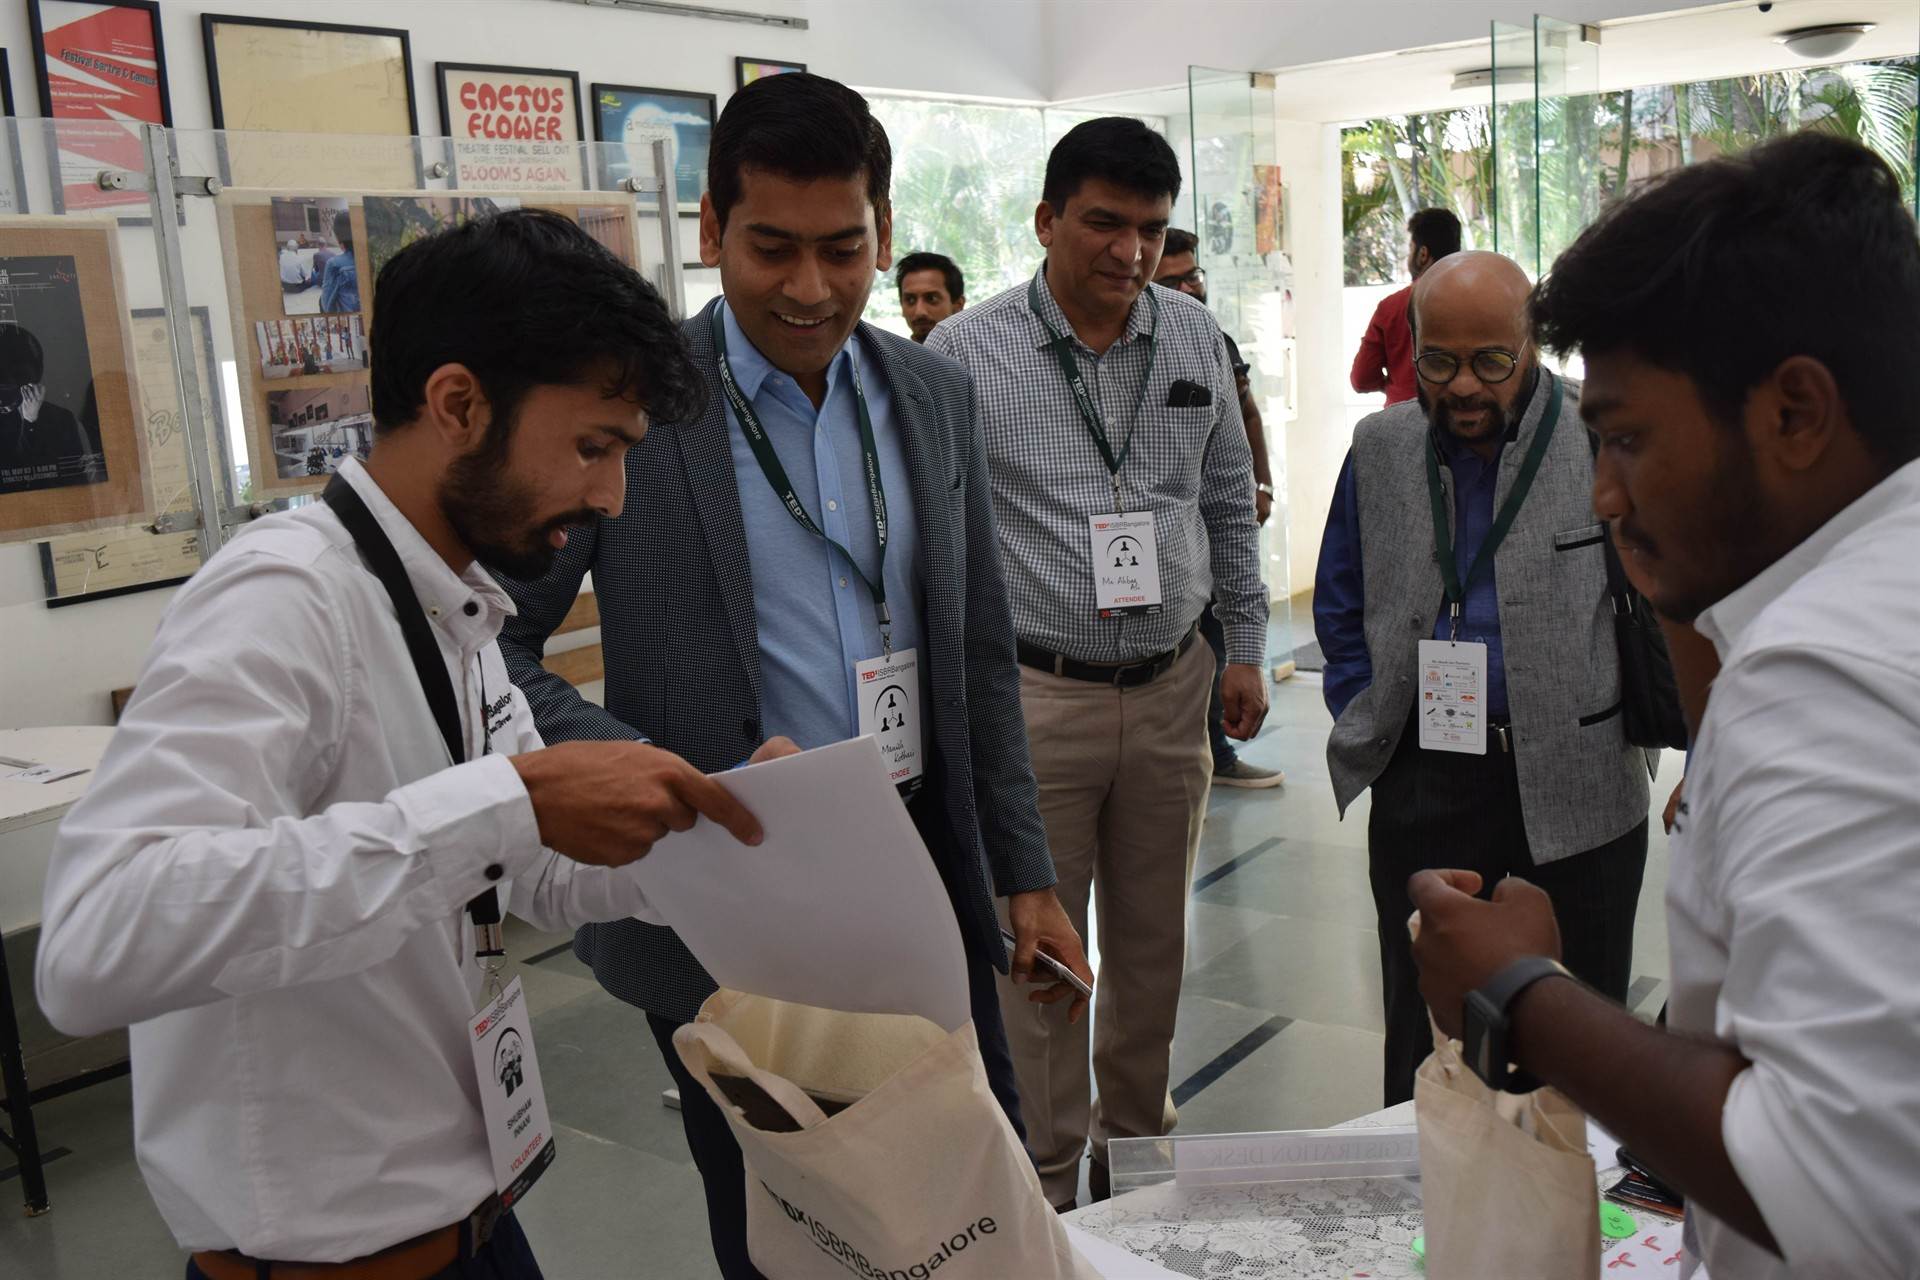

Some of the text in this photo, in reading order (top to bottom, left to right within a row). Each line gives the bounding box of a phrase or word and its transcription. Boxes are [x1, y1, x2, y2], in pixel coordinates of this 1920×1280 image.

[60, 48, 93, 67] Festival
[460, 81, 565, 114] CACTUS
[467, 112, 563, 141] FLOWER
[458, 143, 570, 155] THEATRE FESTIVAL SELL OUT
[461, 164, 522, 182] BLOOMS
[1113, 595, 1146, 604] ATTENDEE
[510, 1132, 543, 1173] VOLUNTEER
